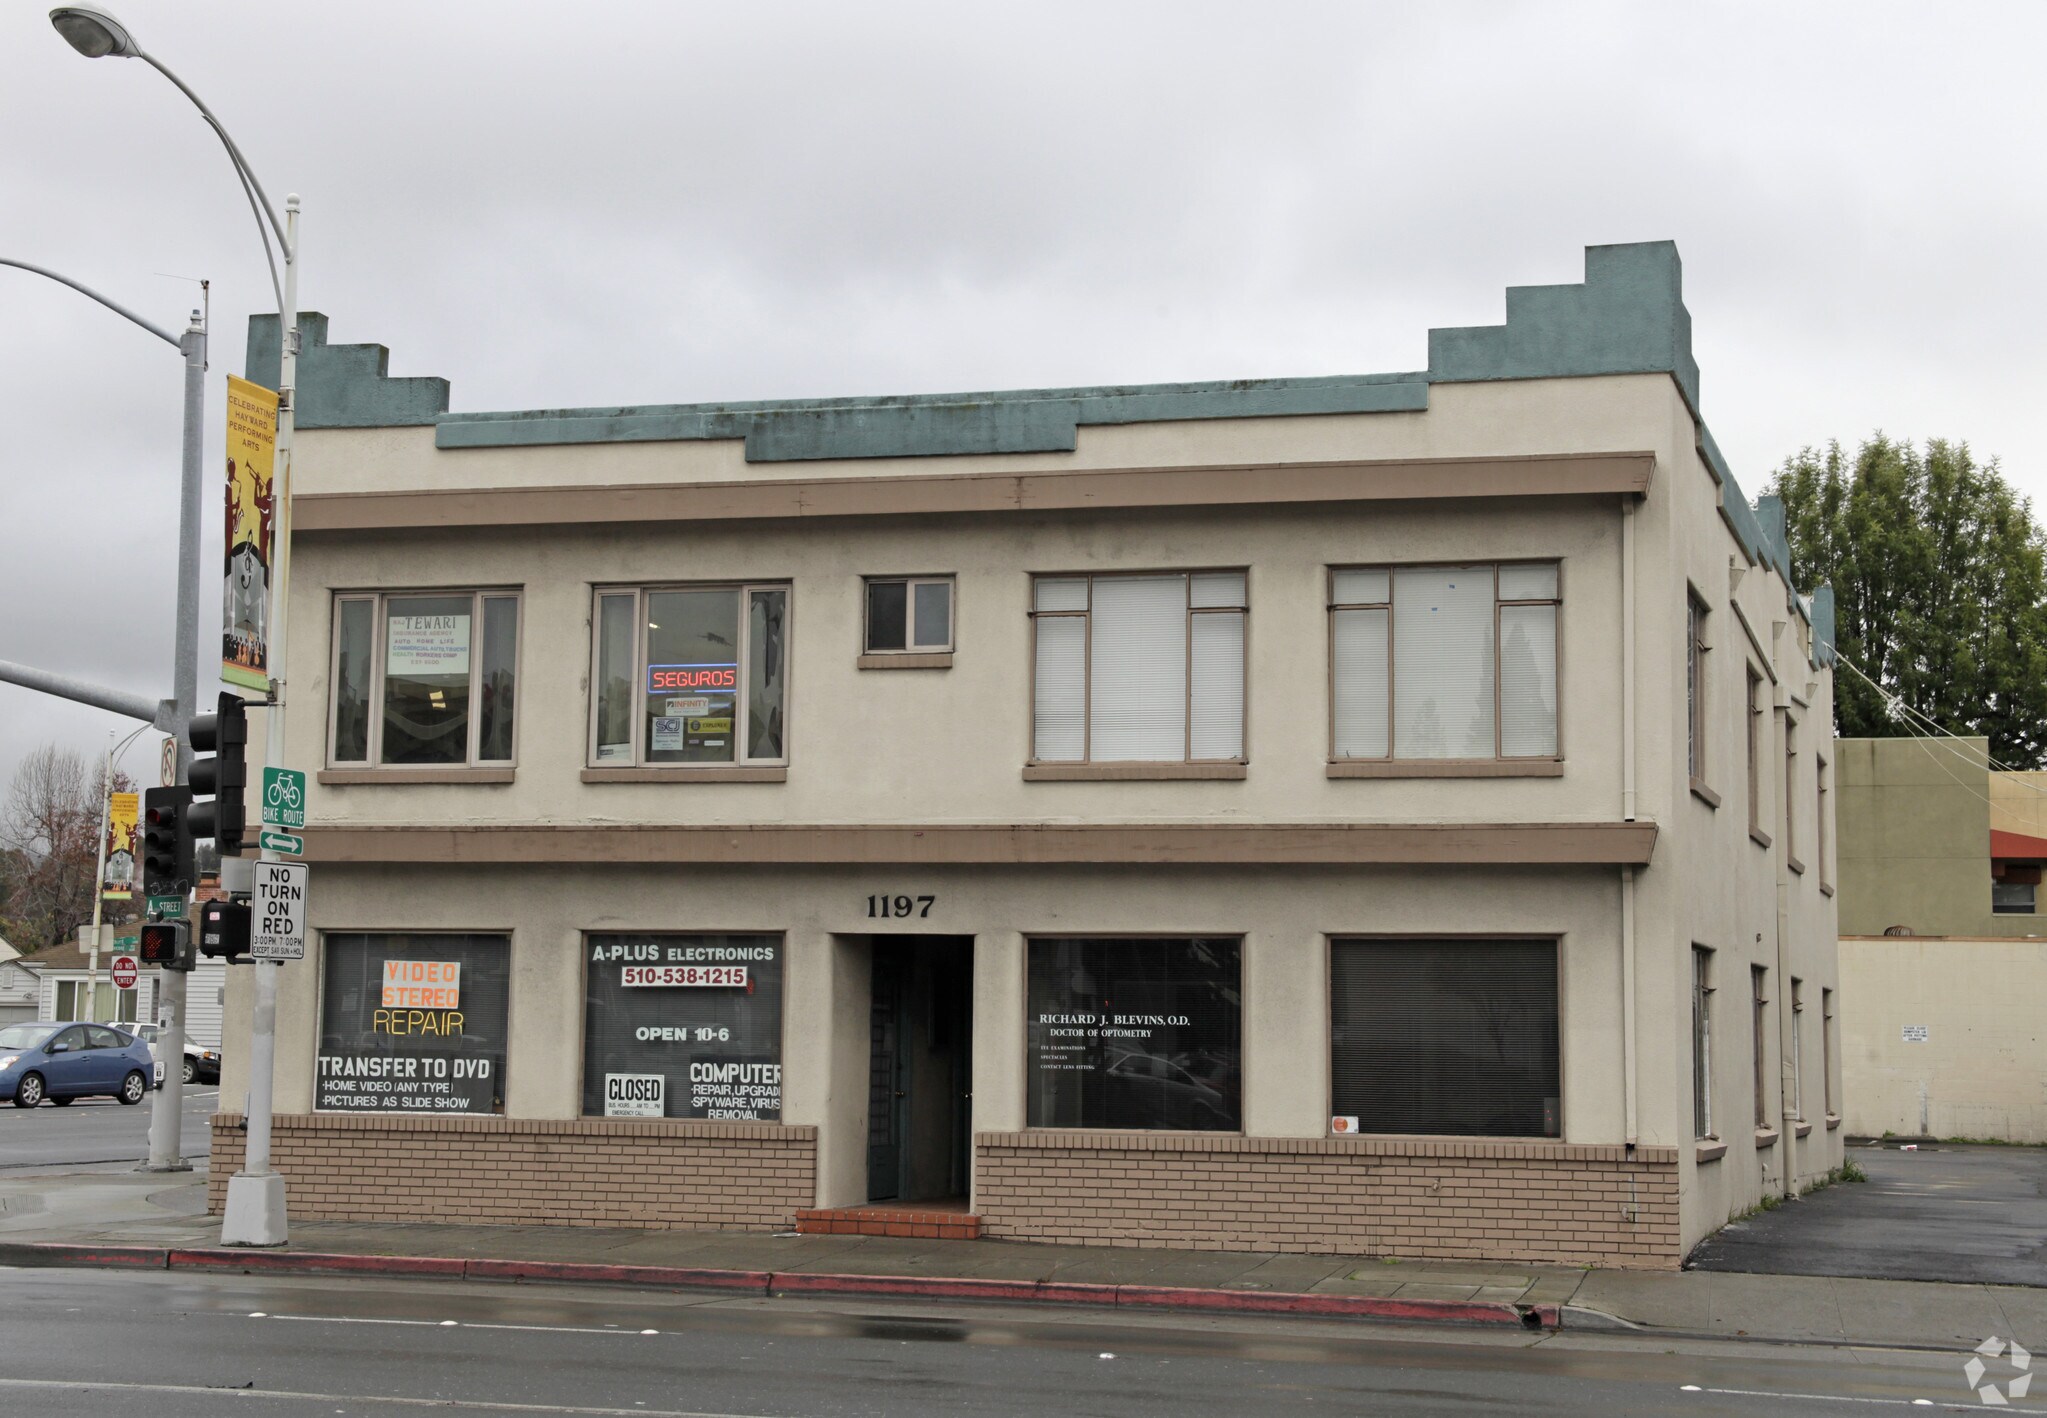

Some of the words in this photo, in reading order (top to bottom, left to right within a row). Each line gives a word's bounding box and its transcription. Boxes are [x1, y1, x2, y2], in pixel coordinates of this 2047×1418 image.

[228, 396, 276, 420] CELEBRATING
[235, 411, 268, 430] HAYWARD
[229, 420, 273, 444] PERFORMING
[242, 438, 260, 452] ARTS
[405, 616, 456, 630] TEWARI
[653, 670, 736, 688] SEGUROS
[674, 700, 707, 708] INFINITY
[263, 806, 278, 822] BIKE
[283, 809, 304, 825] ROUTE
[270, 868, 290, 883] NO
[260, 884, 300, 900] TURN
[147, 900, 154, 915] A
[159, 901, 182, 912] STREET
[268, 901, 288, 916] ON
[867, 894, 936, 918] 1197
[263, 917, 293, 934] RED
[592, 944, 660, 961] A-PLUS
[668, 948, 774, 961] ELECTRONICS
[387, 962, 455, 982] VIDEO
[624, 968, 744, 984] 510-538-1215
[383, 987, 459, 1008] STEREO
[374, 1009, 464, 1036] REPAIR
[1040, 1014, 1096, 1024] RICHARD
[1100, 1014, 1109, 1026] J.
[1114, 1015, 1166, 1026] BLEVINS,
[1168, 1016, 1190, 1026] O.D.
[636, 1027, 687, 1041] OPEN
[694, 1027, 730, 1042] 10-6
[1050, 1028, 1084, 1037] DOCTOR
[1087, 1028, 1098, 1037] OF
[1101, 1029, 1152, 1038] OPTOMETRY
[319, 1056, 417, 1078] TRANSFER
[421, 1058, 446, 1078] TO
[453, 1058, 490, 1078] DVD
[360, 1081, 392, 1092] VIDEO
[394, 1082, 419, 1093] (ANY
[422, 1082, 454, 1093] TYPE)
[609, 1078, 660, 1102] CLOSED
[382, 1096, 398, 1107] AS
[402, 1096, 432, 1108] SLIDE
[434, 1097, 470, 1108] SHOW
[708, 1108, 760, 1120] REMOVAL
